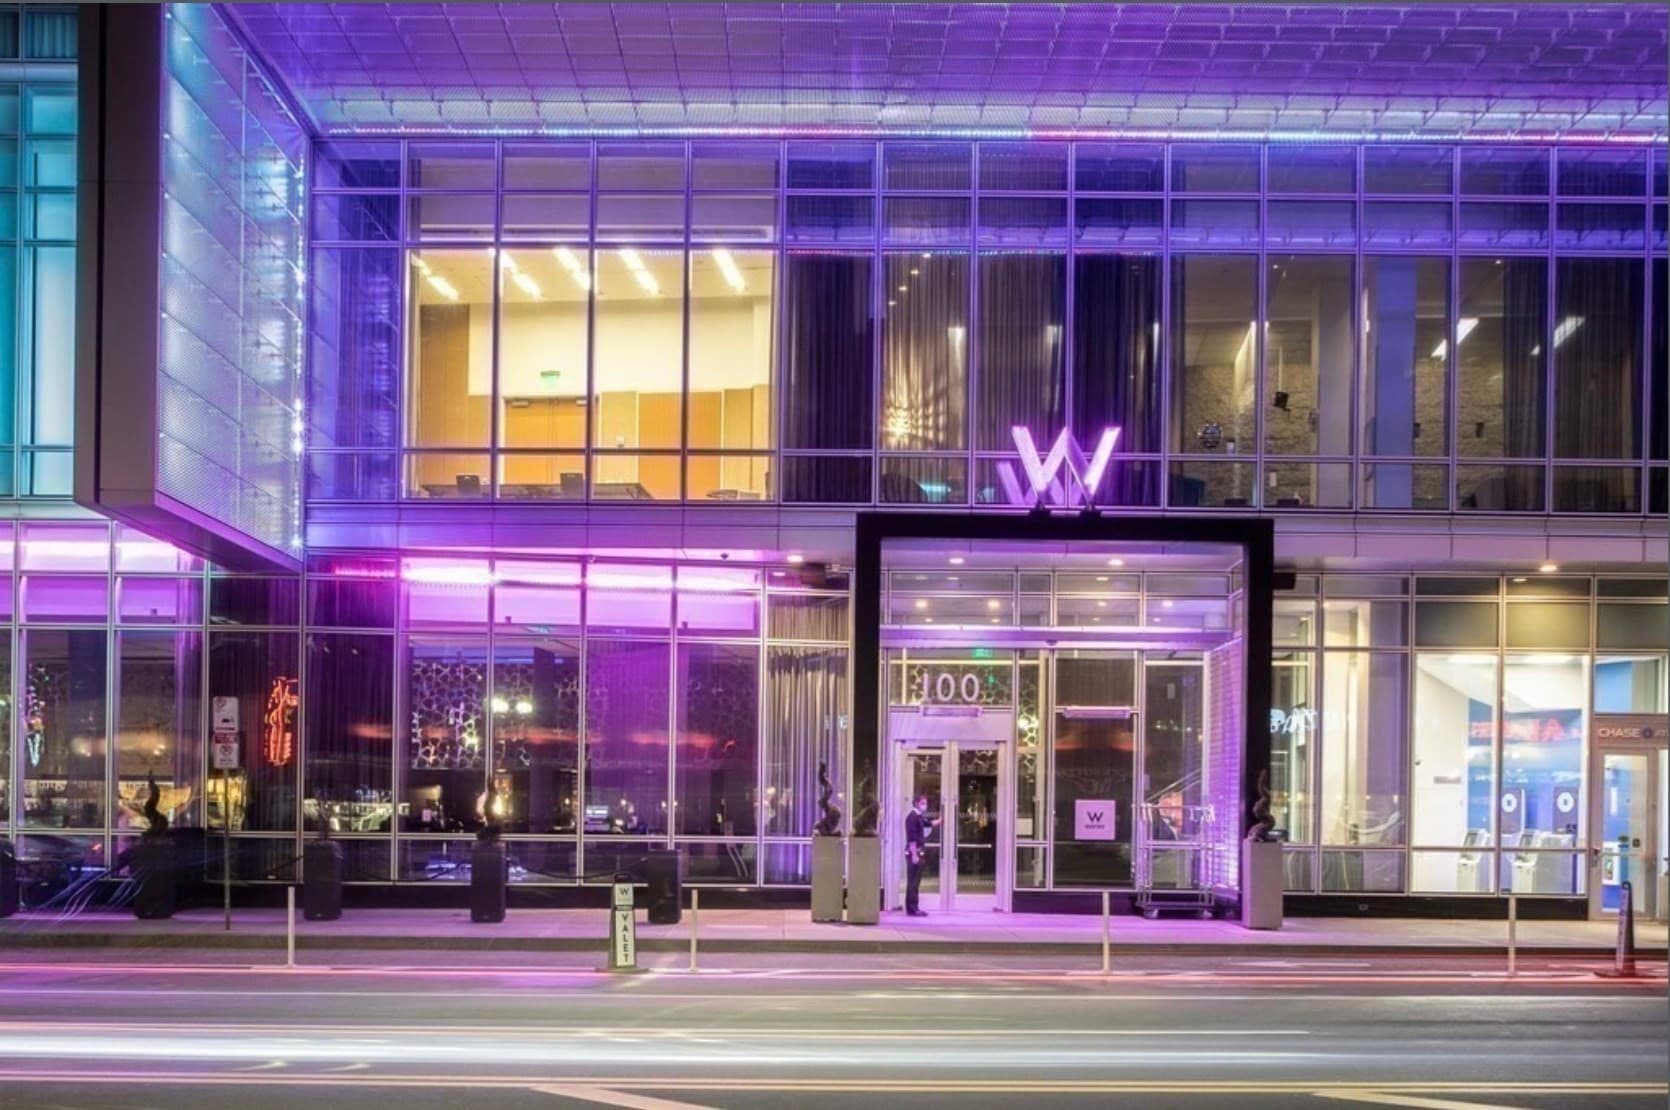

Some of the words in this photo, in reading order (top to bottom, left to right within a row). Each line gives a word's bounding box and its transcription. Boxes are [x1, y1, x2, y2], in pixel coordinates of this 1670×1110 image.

[1011, 425, 1121, 500] W
[923, 673, 980, 701] 100
[1599, 728, 1641, 738] CHASE
[1086, 811, 1104, 822] W
[621, 913, 630, 962] VALET
